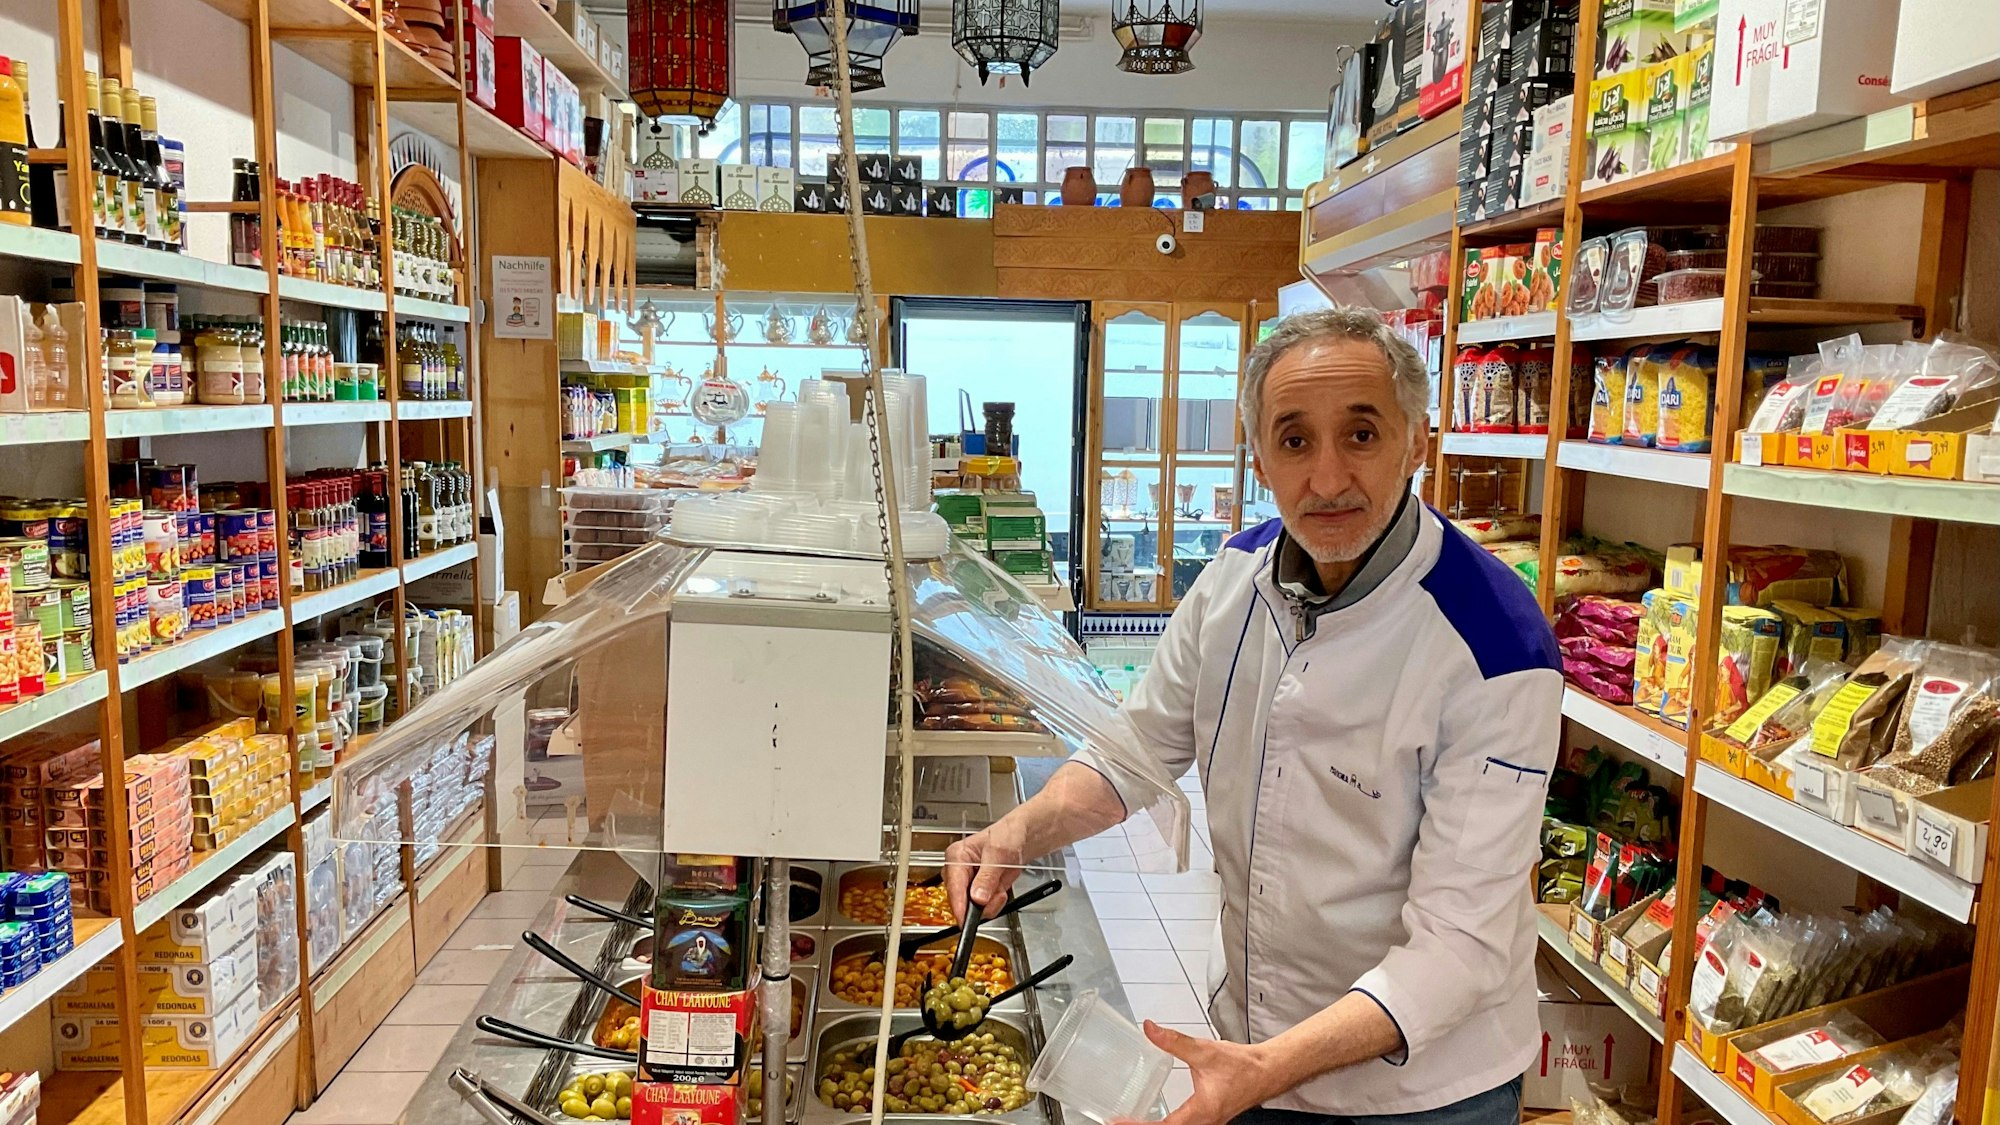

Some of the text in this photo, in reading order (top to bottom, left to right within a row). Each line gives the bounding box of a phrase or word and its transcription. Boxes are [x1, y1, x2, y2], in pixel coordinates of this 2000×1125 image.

[1753, 20, 1777, 44] MUY
[1746, 41, 1780, 68] FRÁGIL
[1858, 74, 1891, 87] Consé
[498, 260, 545, 271] Nachhilfe
[1661, 393, 1680, 405] DARI
[1922, 827, 1948, 850] 2,90
[140, 839, 155, 854] RIO
[154, 951, 194, 959] REDONDAS
[67, 1001, 196, 1010] MAGDALENAS REDONDAS
[655, 991, 732, 1008] CHAY LAAYOUNE
[1562, 1044, 1592, 1055] MUY
[71, 1055, 201, 1064] MAGDALENAS REDONDAS
[1554, 1056, 1598, 1070] FRÁGIL
[645, 1087, 721, 1104] CHAY LAAYOUNE
